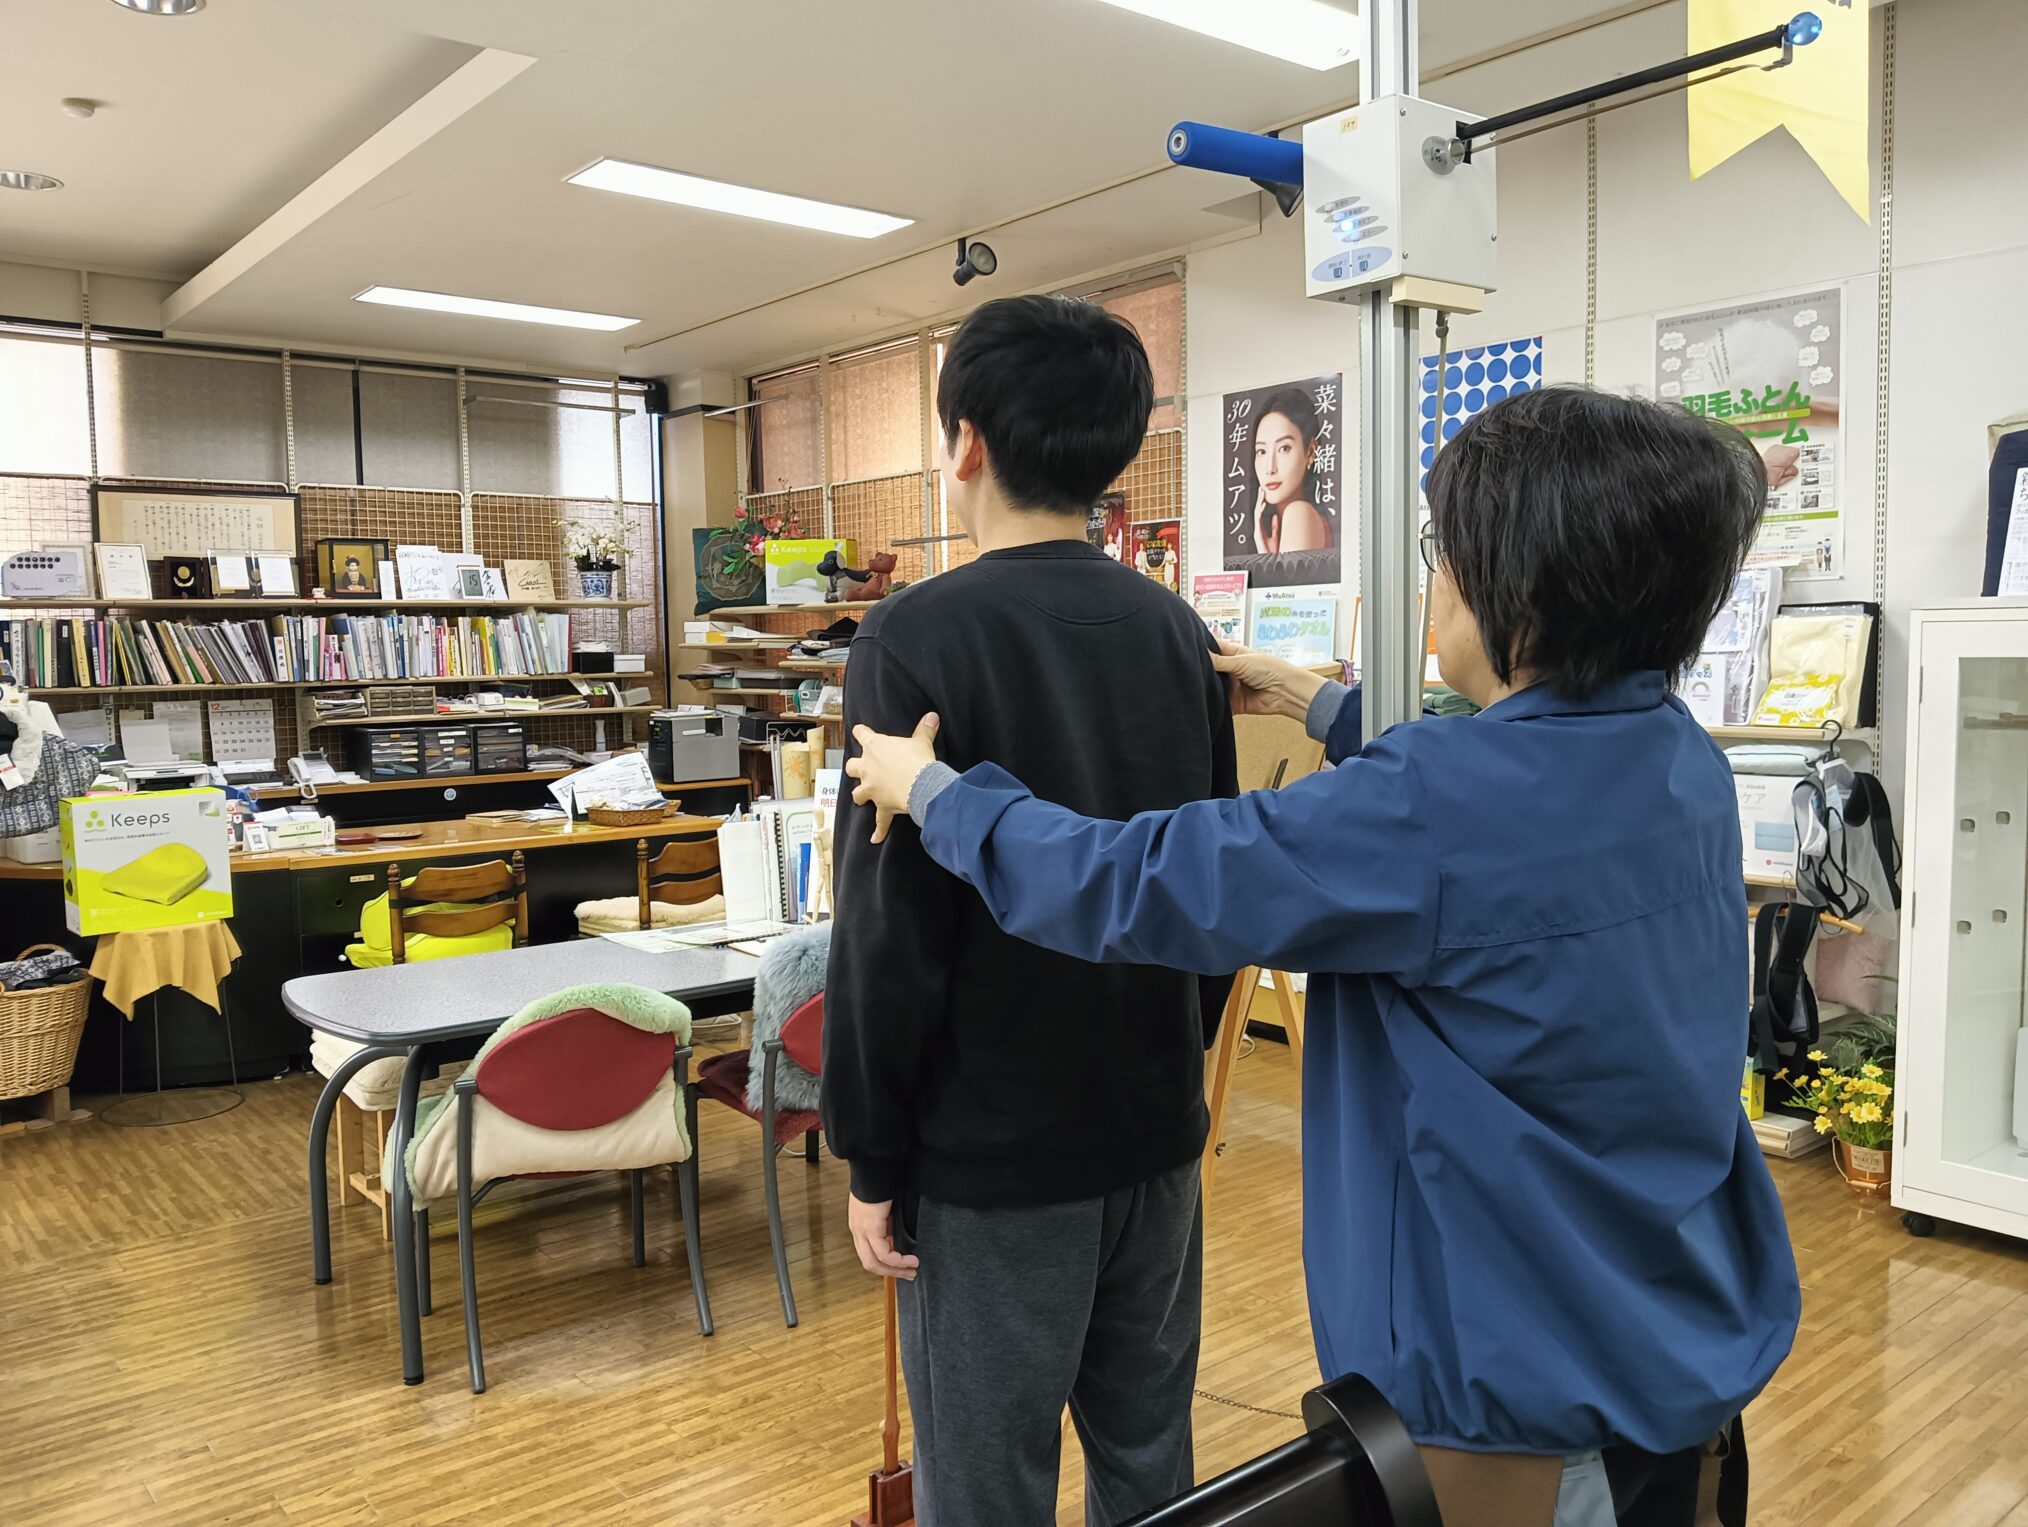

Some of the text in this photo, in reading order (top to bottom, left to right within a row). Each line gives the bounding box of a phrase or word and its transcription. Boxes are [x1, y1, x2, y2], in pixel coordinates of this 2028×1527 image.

[1227, 398, 1251, 545] 30年ムアツ。
[1313, 384, 1337, 516] 菜々緒は、
[111, 811, 170, 829] Keeps
[822, 787, 840, 796] 身体
